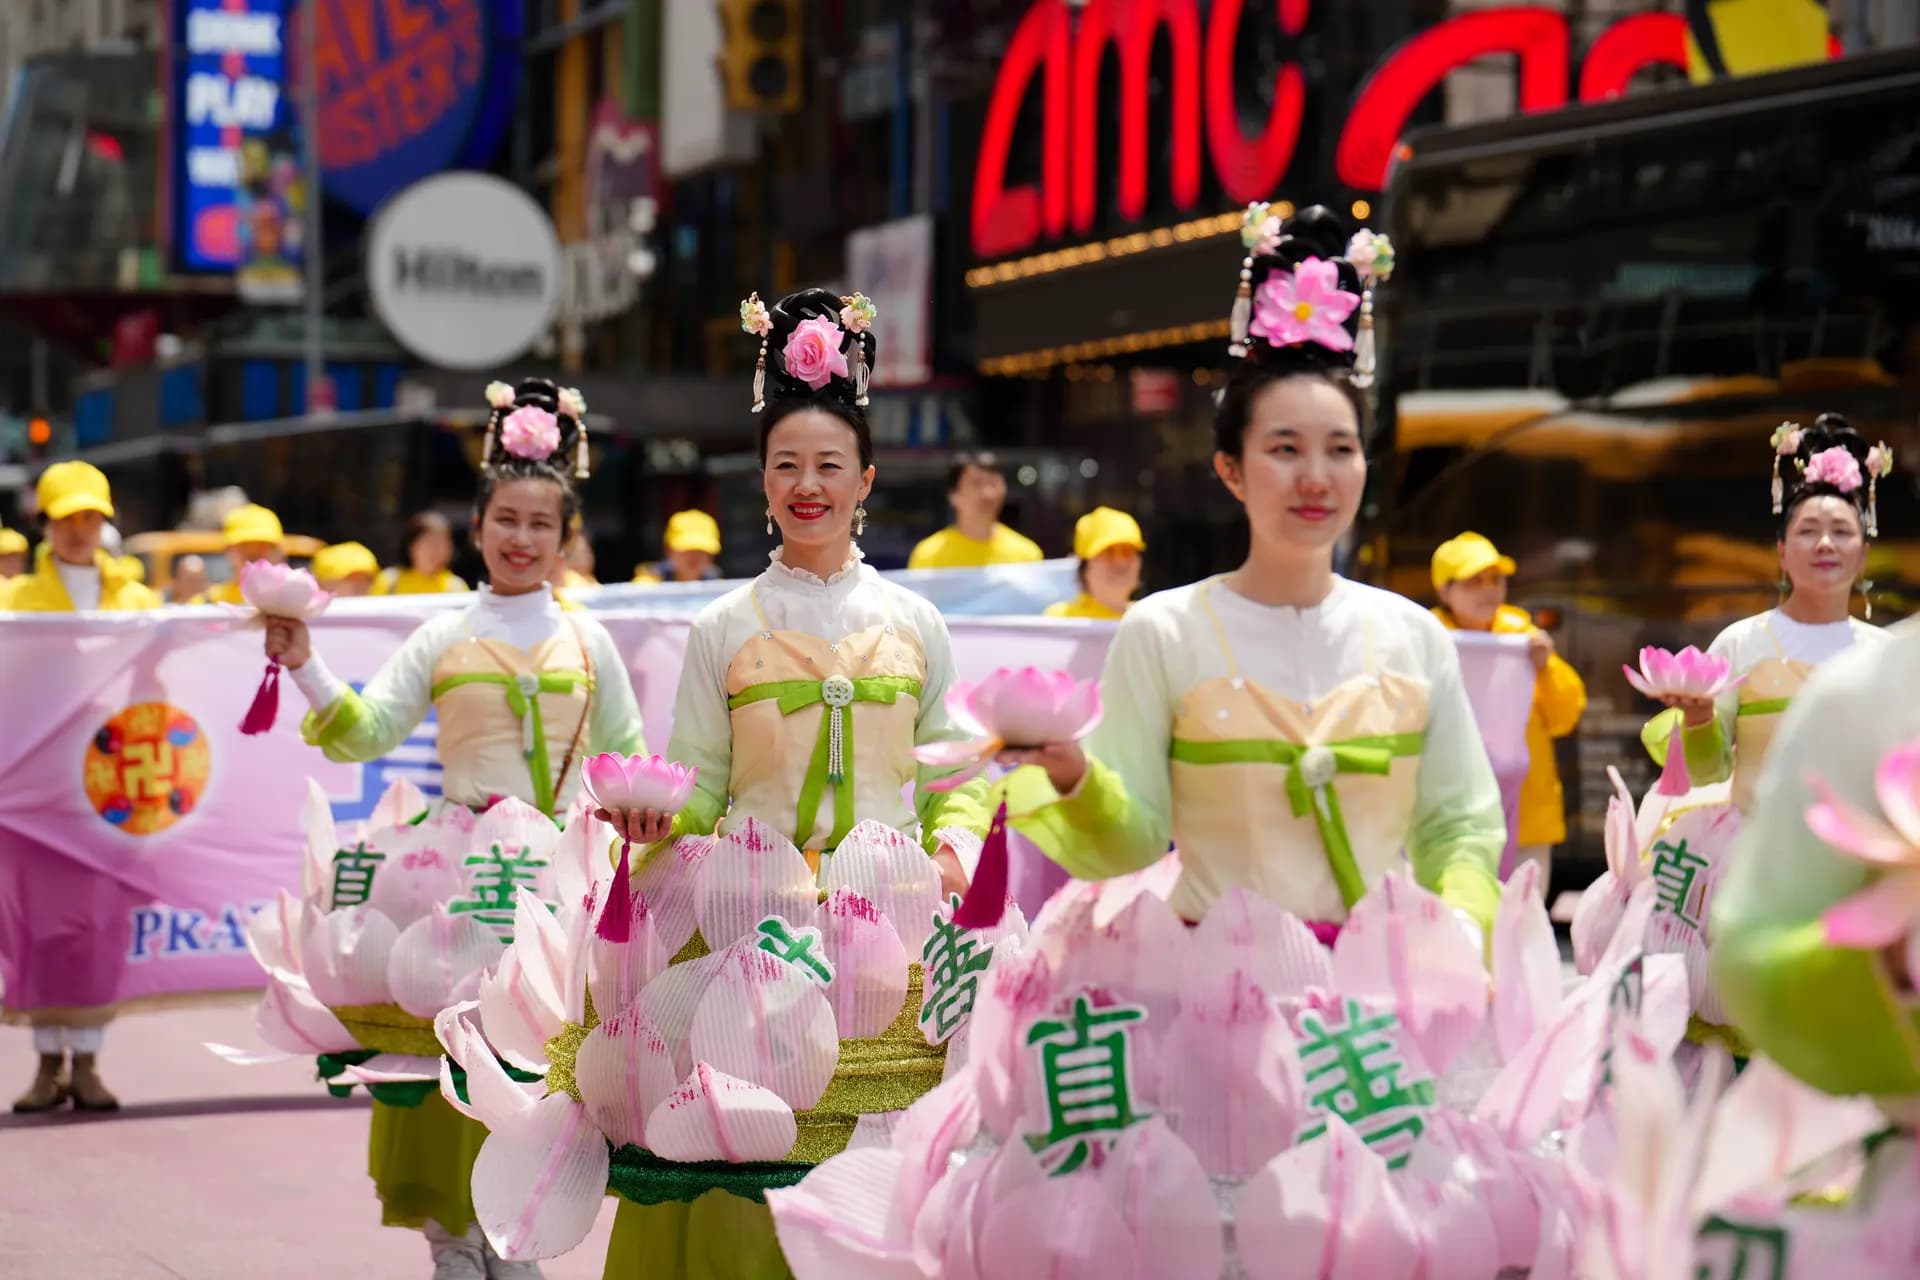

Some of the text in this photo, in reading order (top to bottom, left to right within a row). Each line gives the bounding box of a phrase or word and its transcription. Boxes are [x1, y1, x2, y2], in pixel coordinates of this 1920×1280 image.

[395, 245, 544, 298] Hilton
[448, 844, 557, 944] 善
[1027, 997, 1148, 1176] 真
[1298, 1000, 1435, 1171] 善
